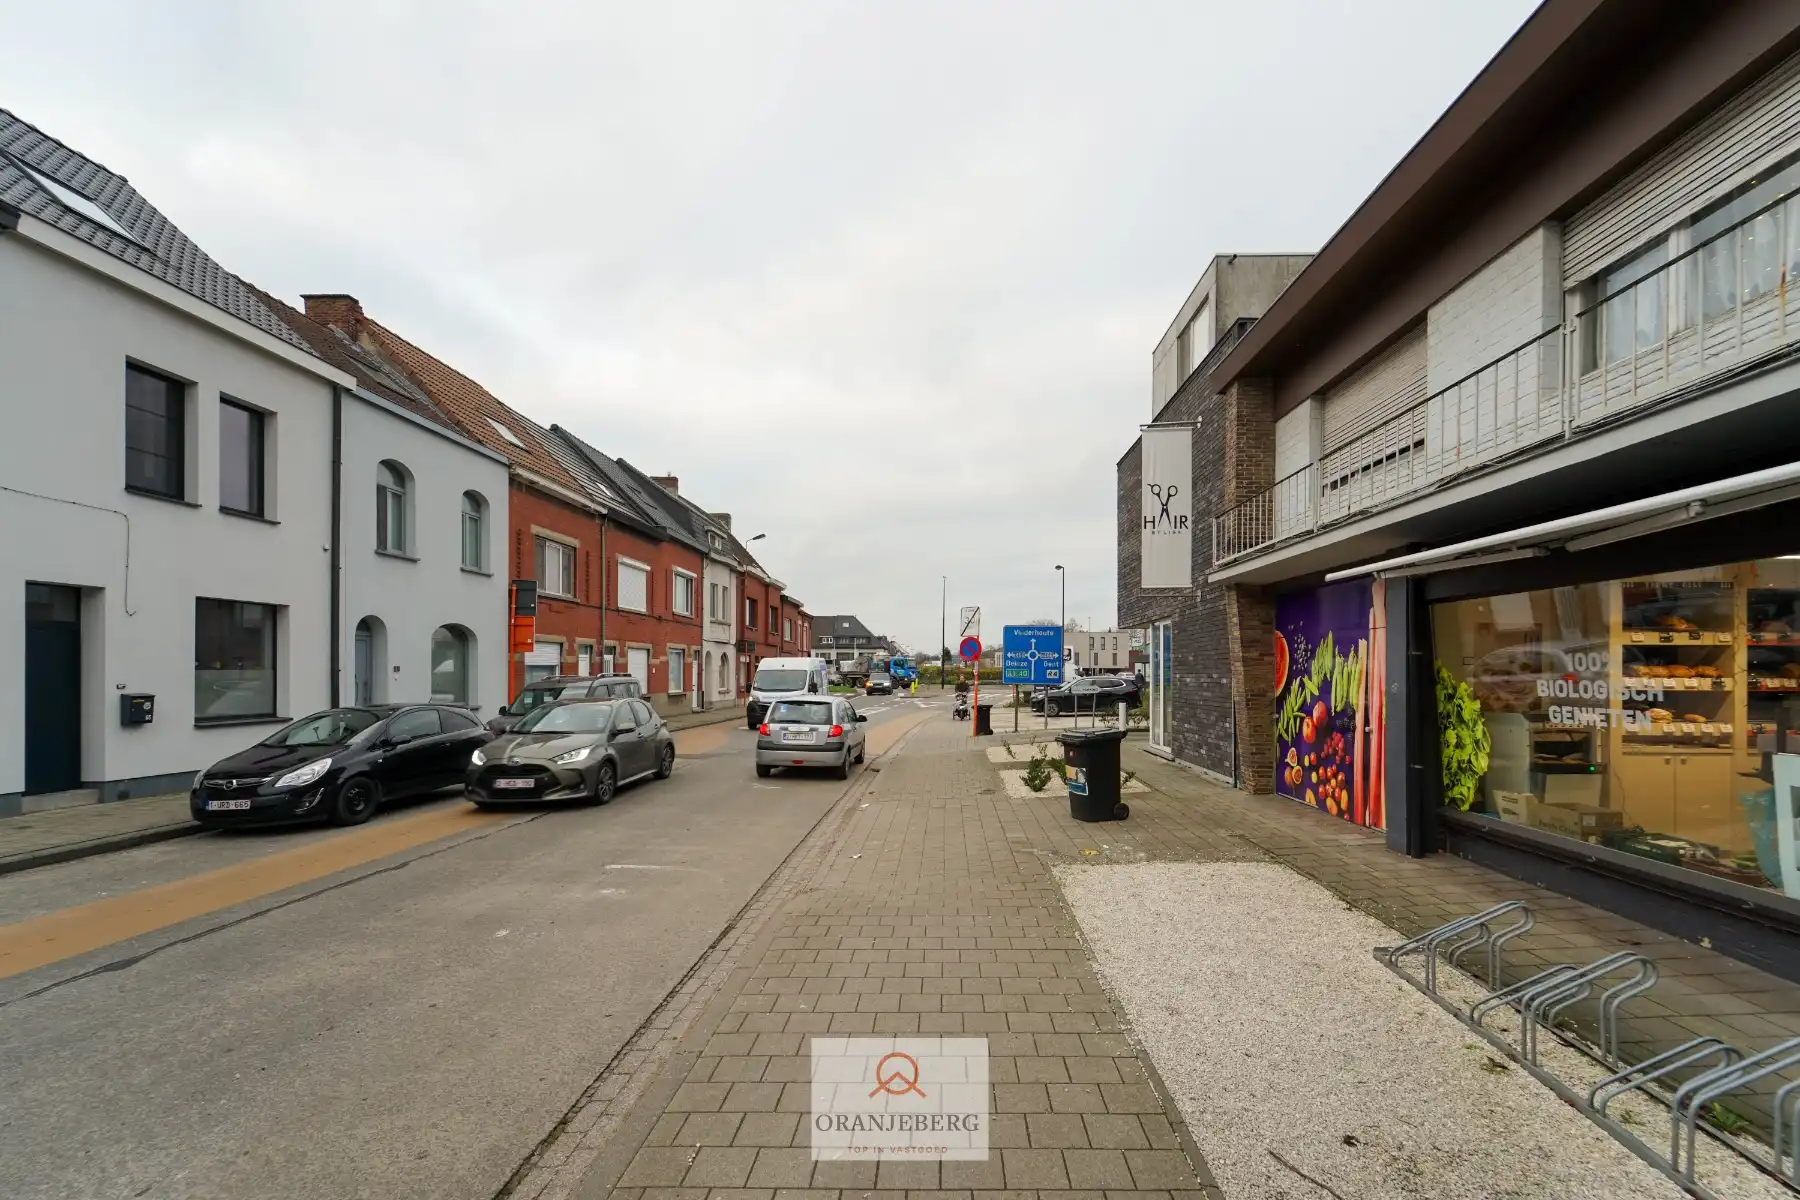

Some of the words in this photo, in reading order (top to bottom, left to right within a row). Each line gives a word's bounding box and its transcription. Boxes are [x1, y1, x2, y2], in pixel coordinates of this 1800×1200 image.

[1143, 506, 1189, 530] HAIR
[1536, 679, 1664, 702] BIOLOGISCH
[1548, 705, 1652, 731] GENIETEN
